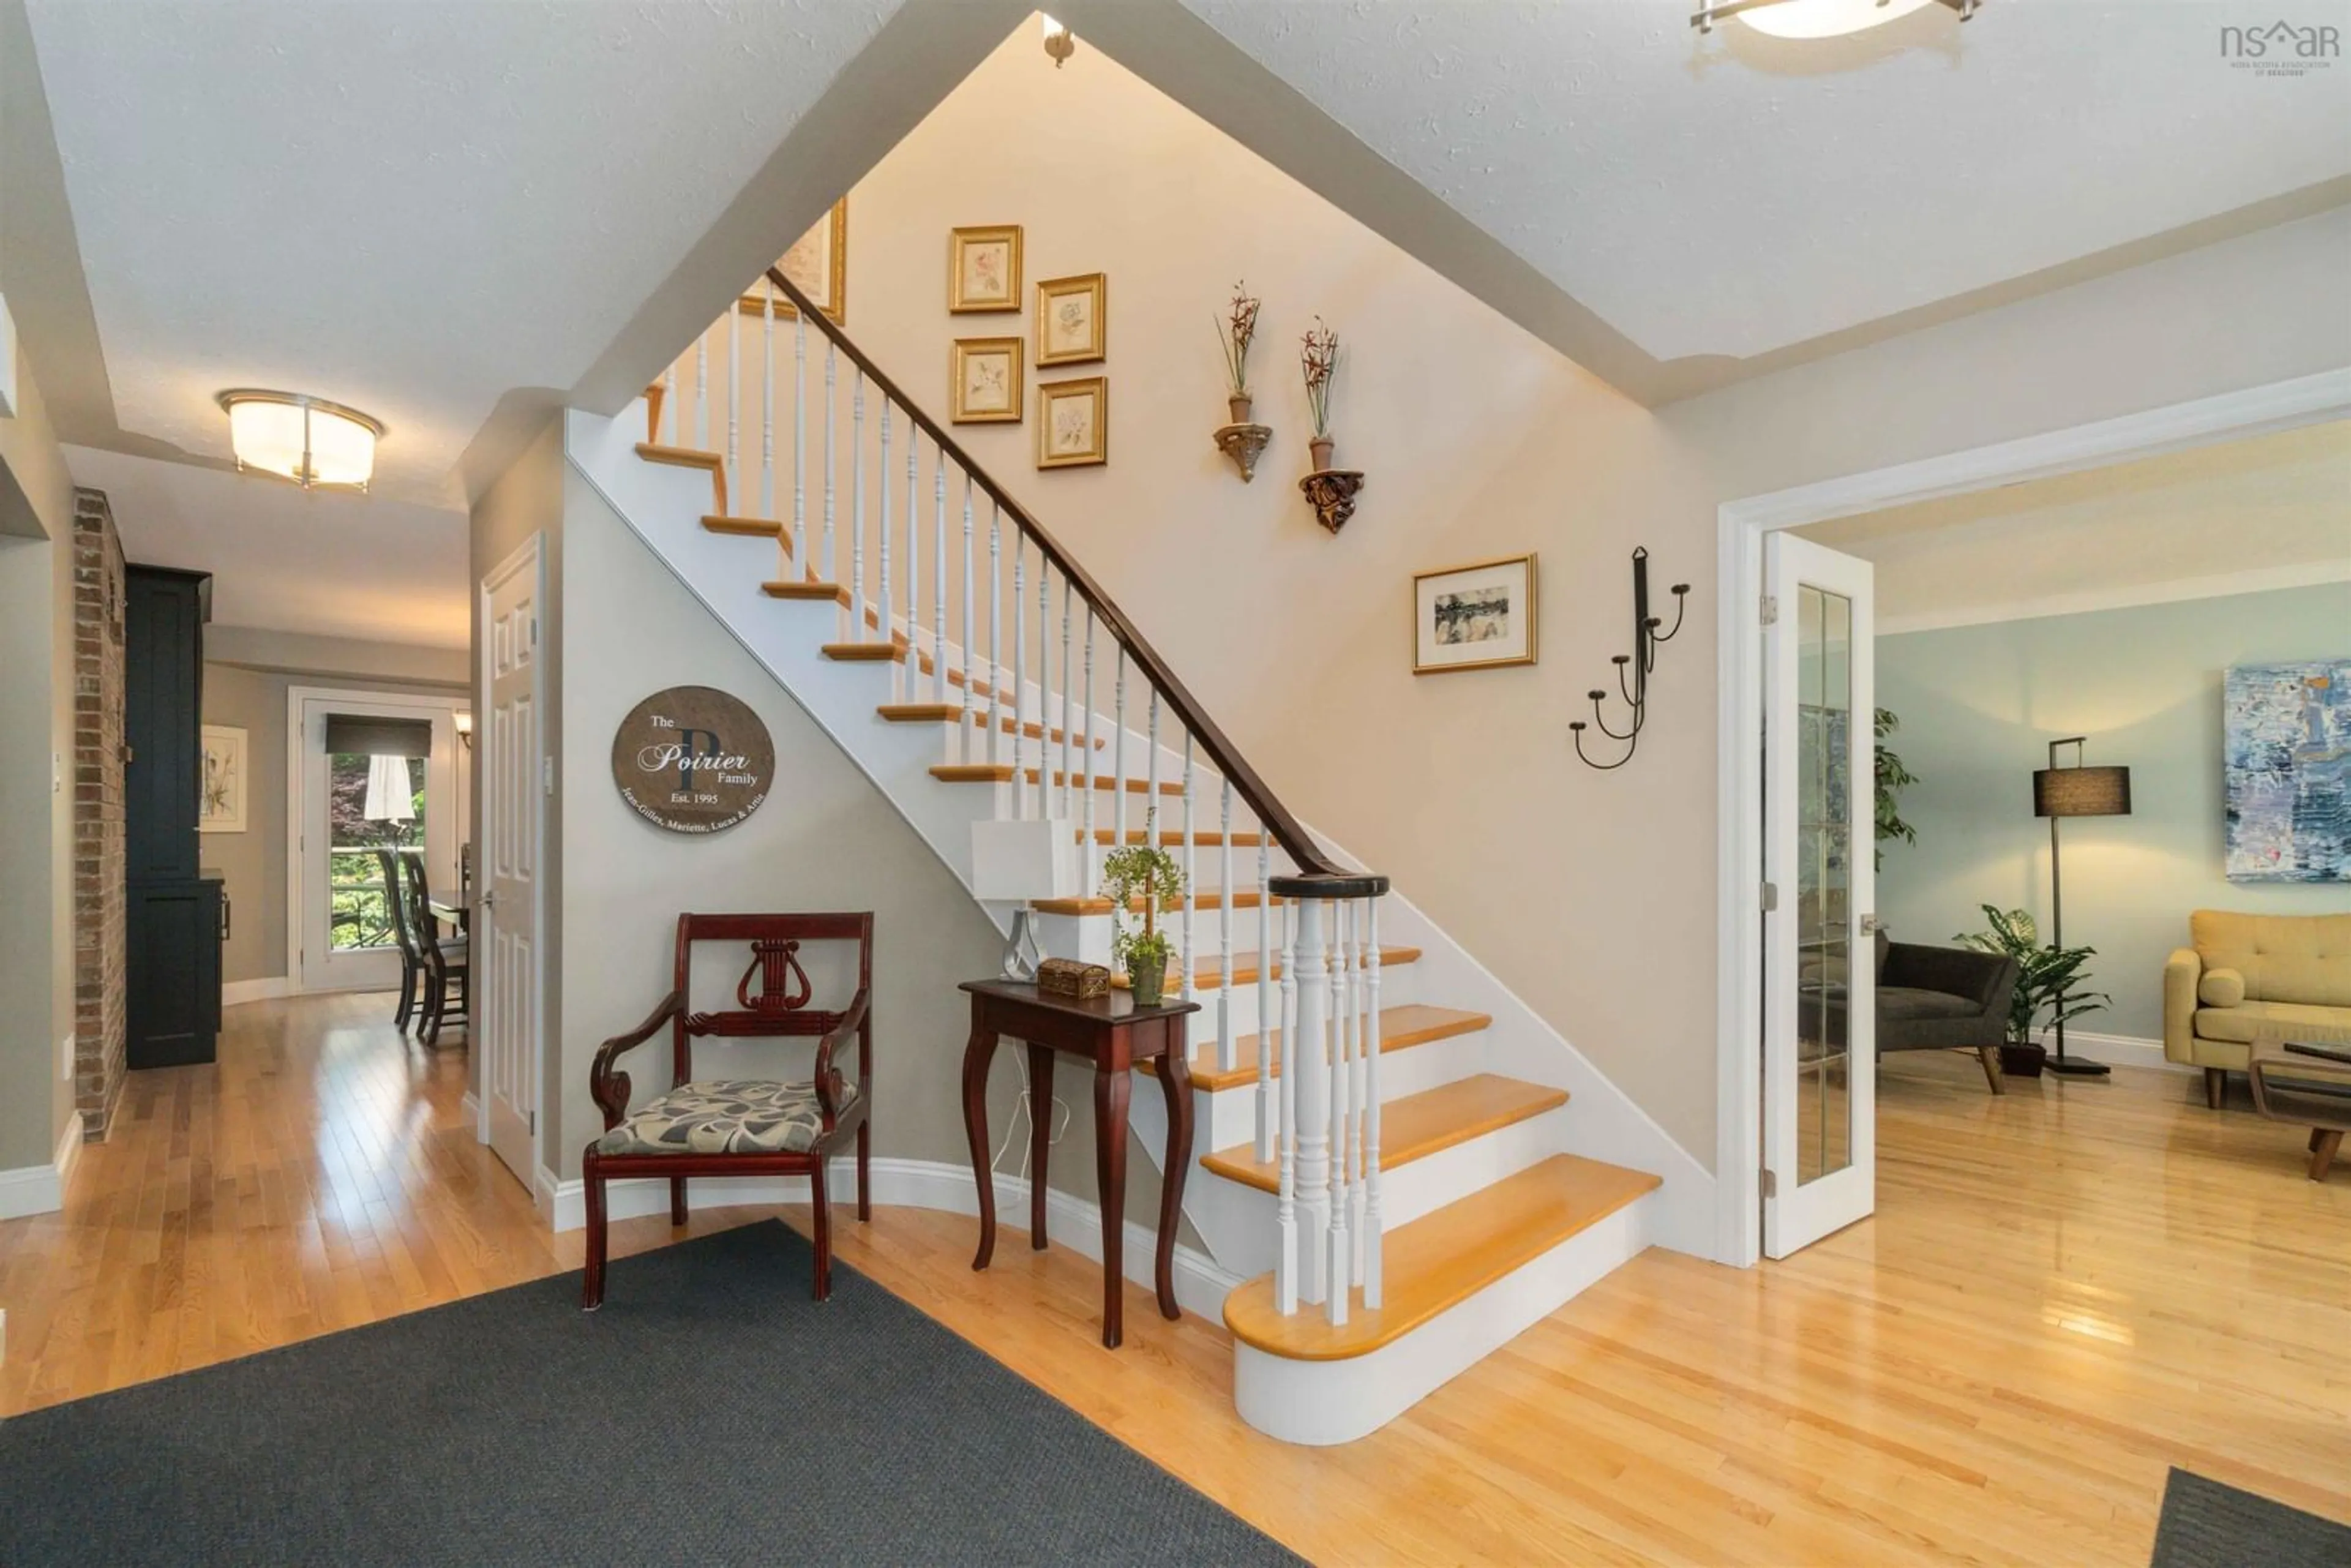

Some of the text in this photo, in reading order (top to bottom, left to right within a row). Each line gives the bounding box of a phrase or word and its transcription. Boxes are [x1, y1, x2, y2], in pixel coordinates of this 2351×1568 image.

[650, 715, 674, 727] The
[637, 743, 751, 771] Poirier
[673, 727, 721, 792] P
[718, 772, 757, 787] Family
[671, 793, 718, 805] Est. 1995
[737, 810, 748, 820] &
